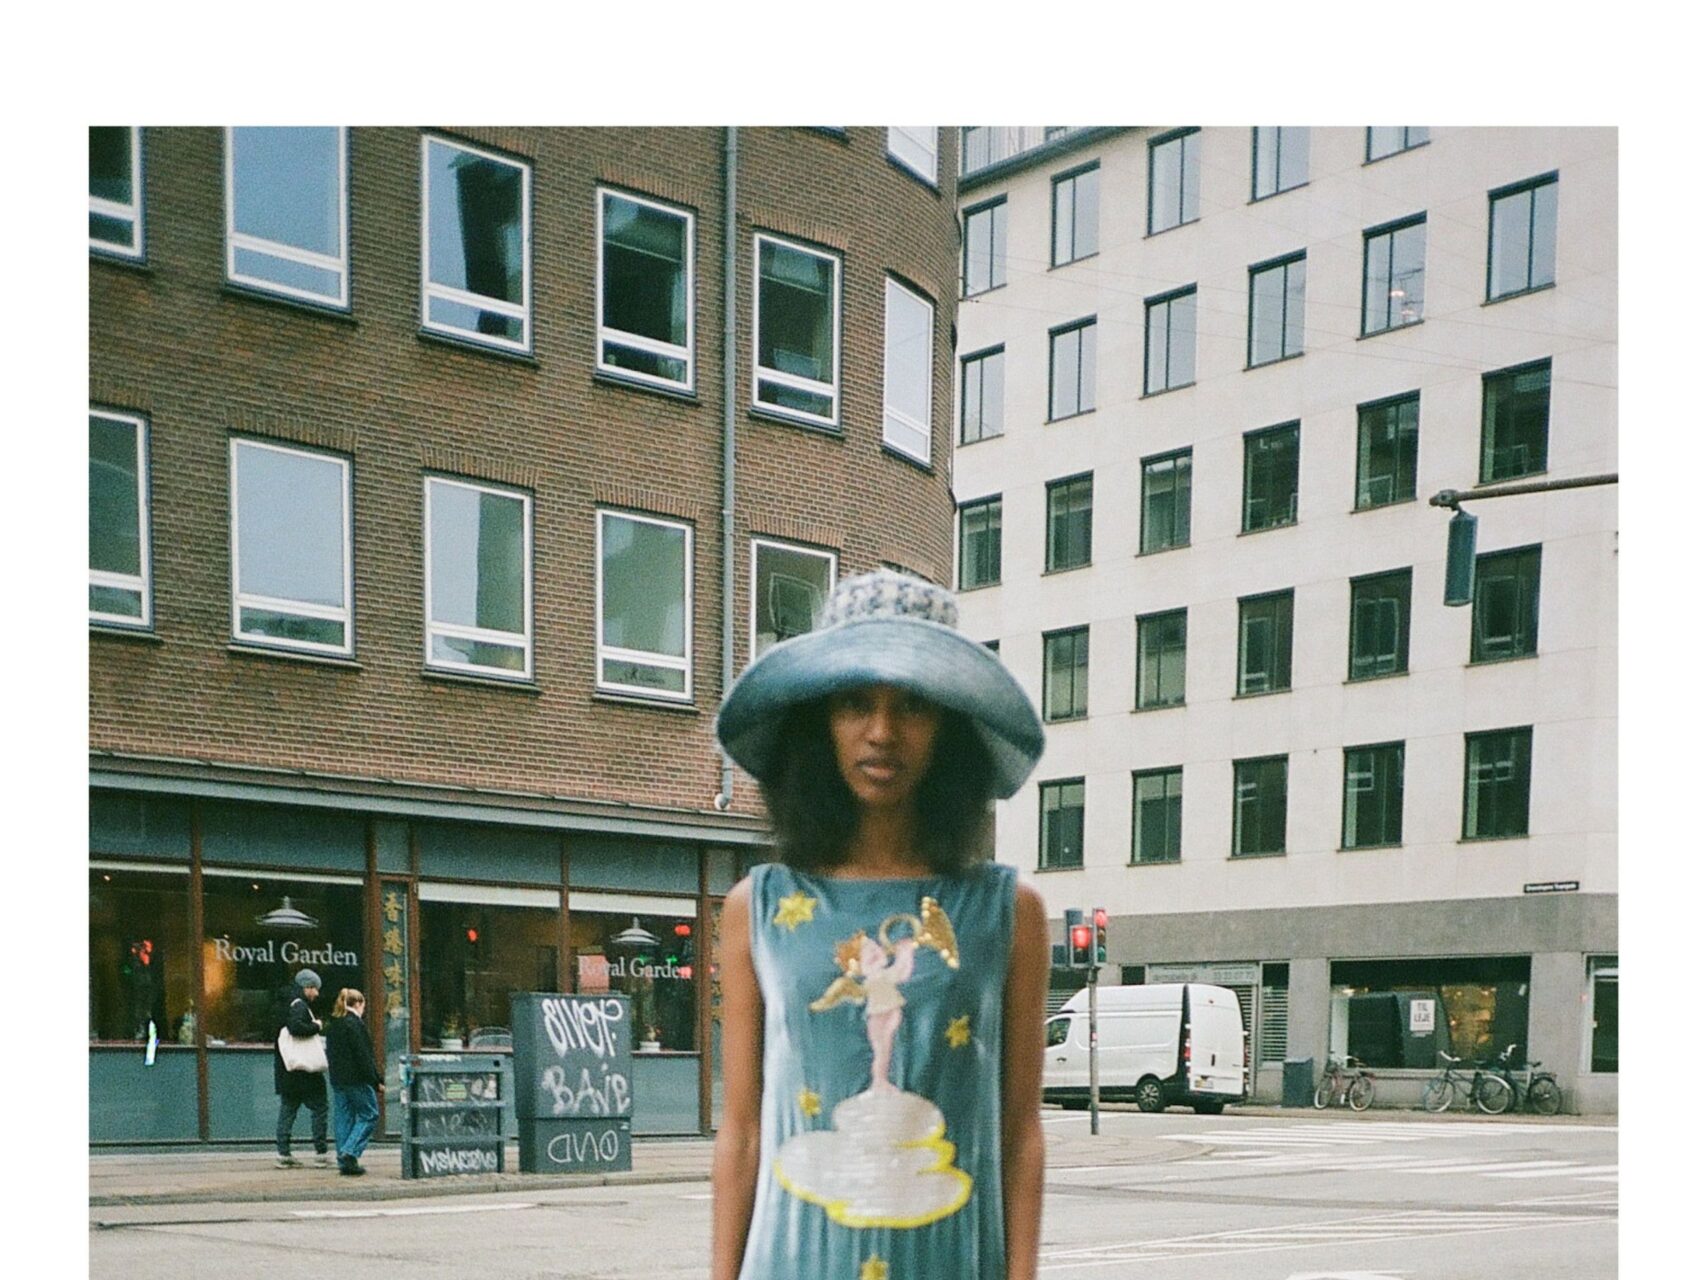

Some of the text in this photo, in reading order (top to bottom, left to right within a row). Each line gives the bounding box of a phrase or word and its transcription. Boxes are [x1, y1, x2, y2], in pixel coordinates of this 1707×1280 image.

[213, 938, 358, 966] Royal Garden
[629, 957, 692, 980] Garden
